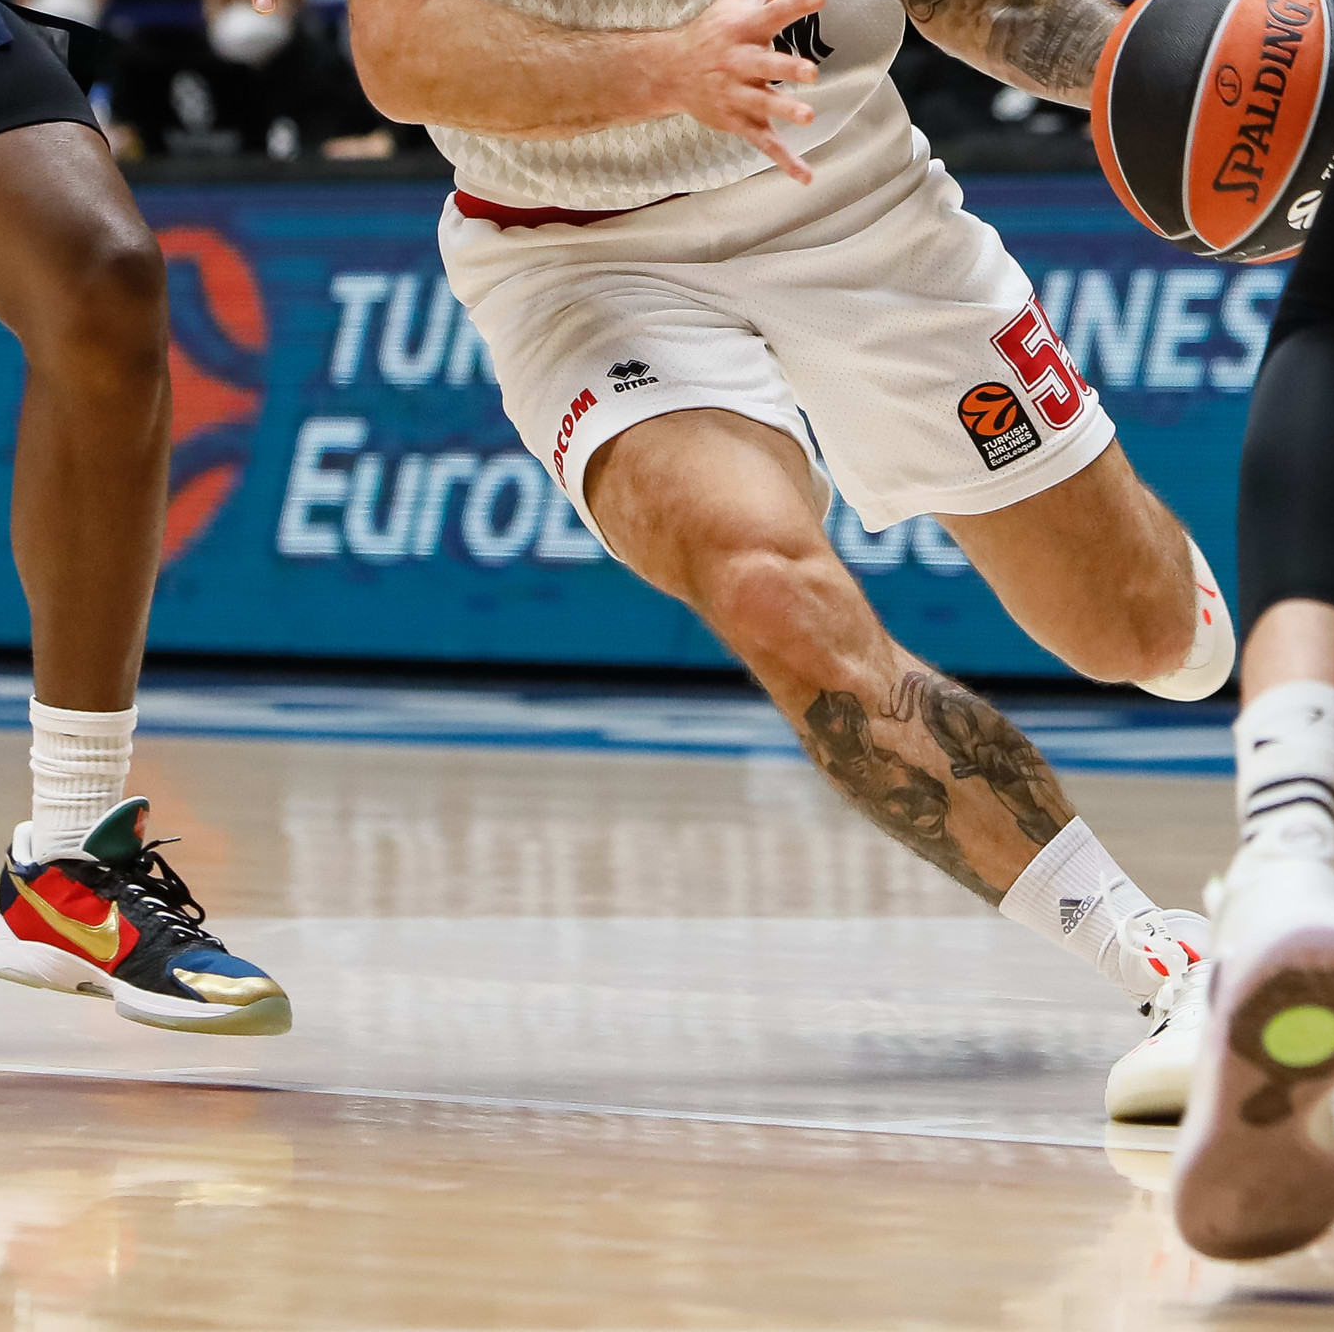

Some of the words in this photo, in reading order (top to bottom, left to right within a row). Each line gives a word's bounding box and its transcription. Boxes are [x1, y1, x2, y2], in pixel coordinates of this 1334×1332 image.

[982, 422, 1029, 453] TURKISH
[987, 431, 1034, 460] AIRLINES
[990, 439, 1037, 468] EuroLeague
[1063, 895, 1096, 935] adidas
